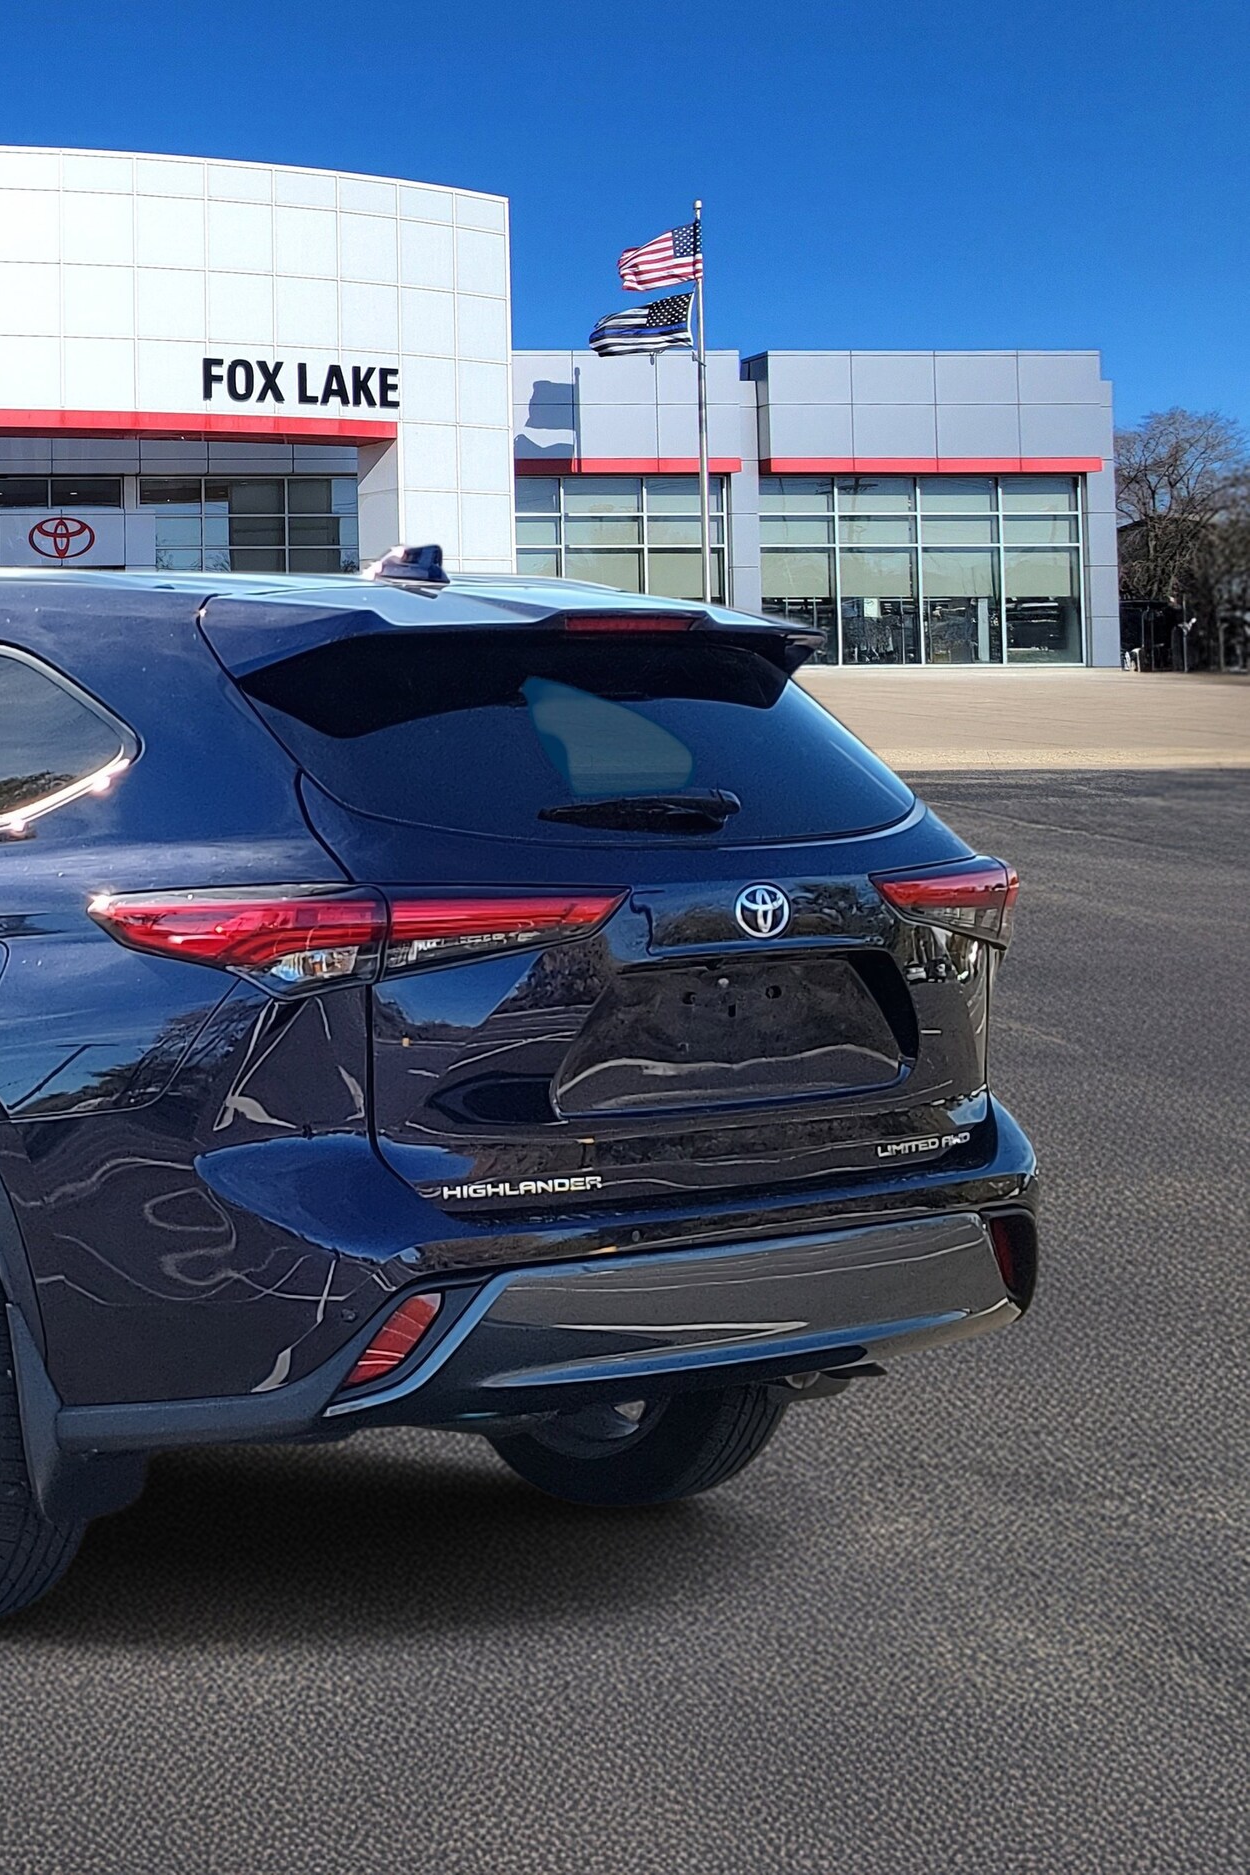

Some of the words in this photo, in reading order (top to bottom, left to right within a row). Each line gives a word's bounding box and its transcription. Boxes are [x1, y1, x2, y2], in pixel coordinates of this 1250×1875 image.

[202, 357, 286, 403] FOX
[297, 362, 401, 408] LAKE
[877, 1137, 939, 1158] LIMITED
[941, 1132, 971, 1149] AWD
[442, 1175, 602, 1200] HIGHLANDER
